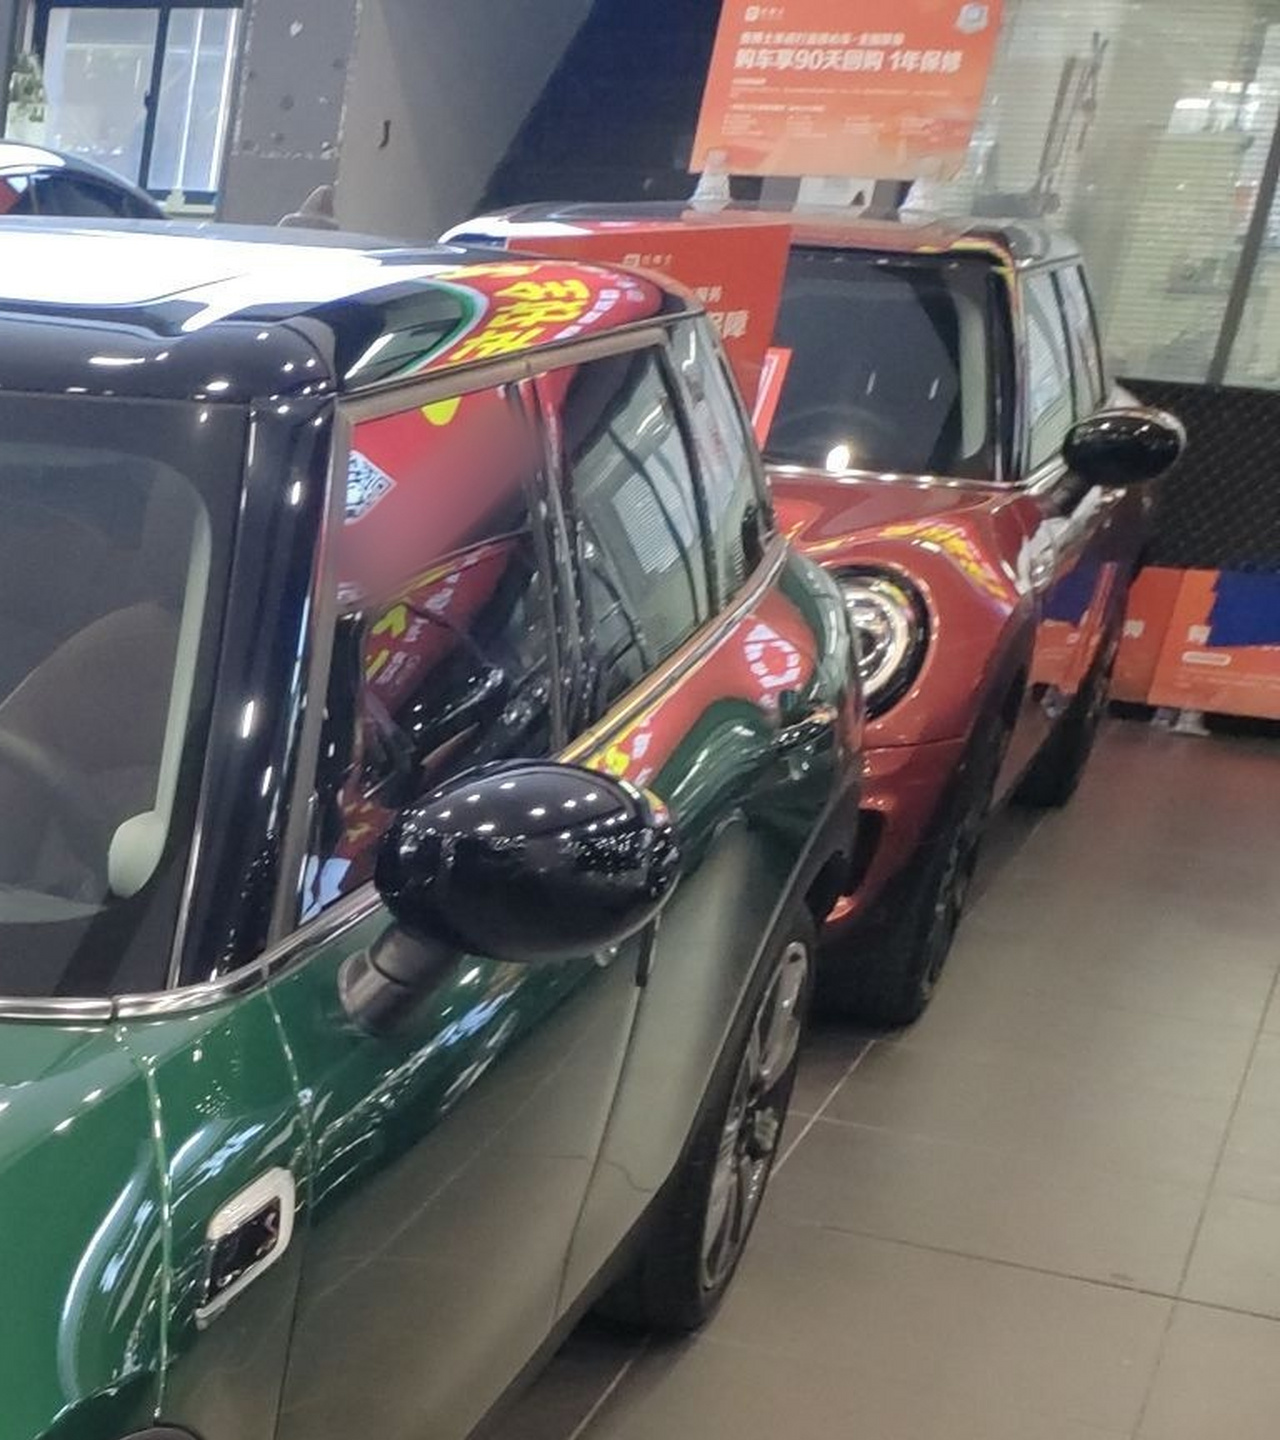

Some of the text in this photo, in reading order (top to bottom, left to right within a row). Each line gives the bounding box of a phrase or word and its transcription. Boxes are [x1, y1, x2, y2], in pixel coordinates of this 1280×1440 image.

[733, 48, 963, 73] 购车享90天回购 1年保修
